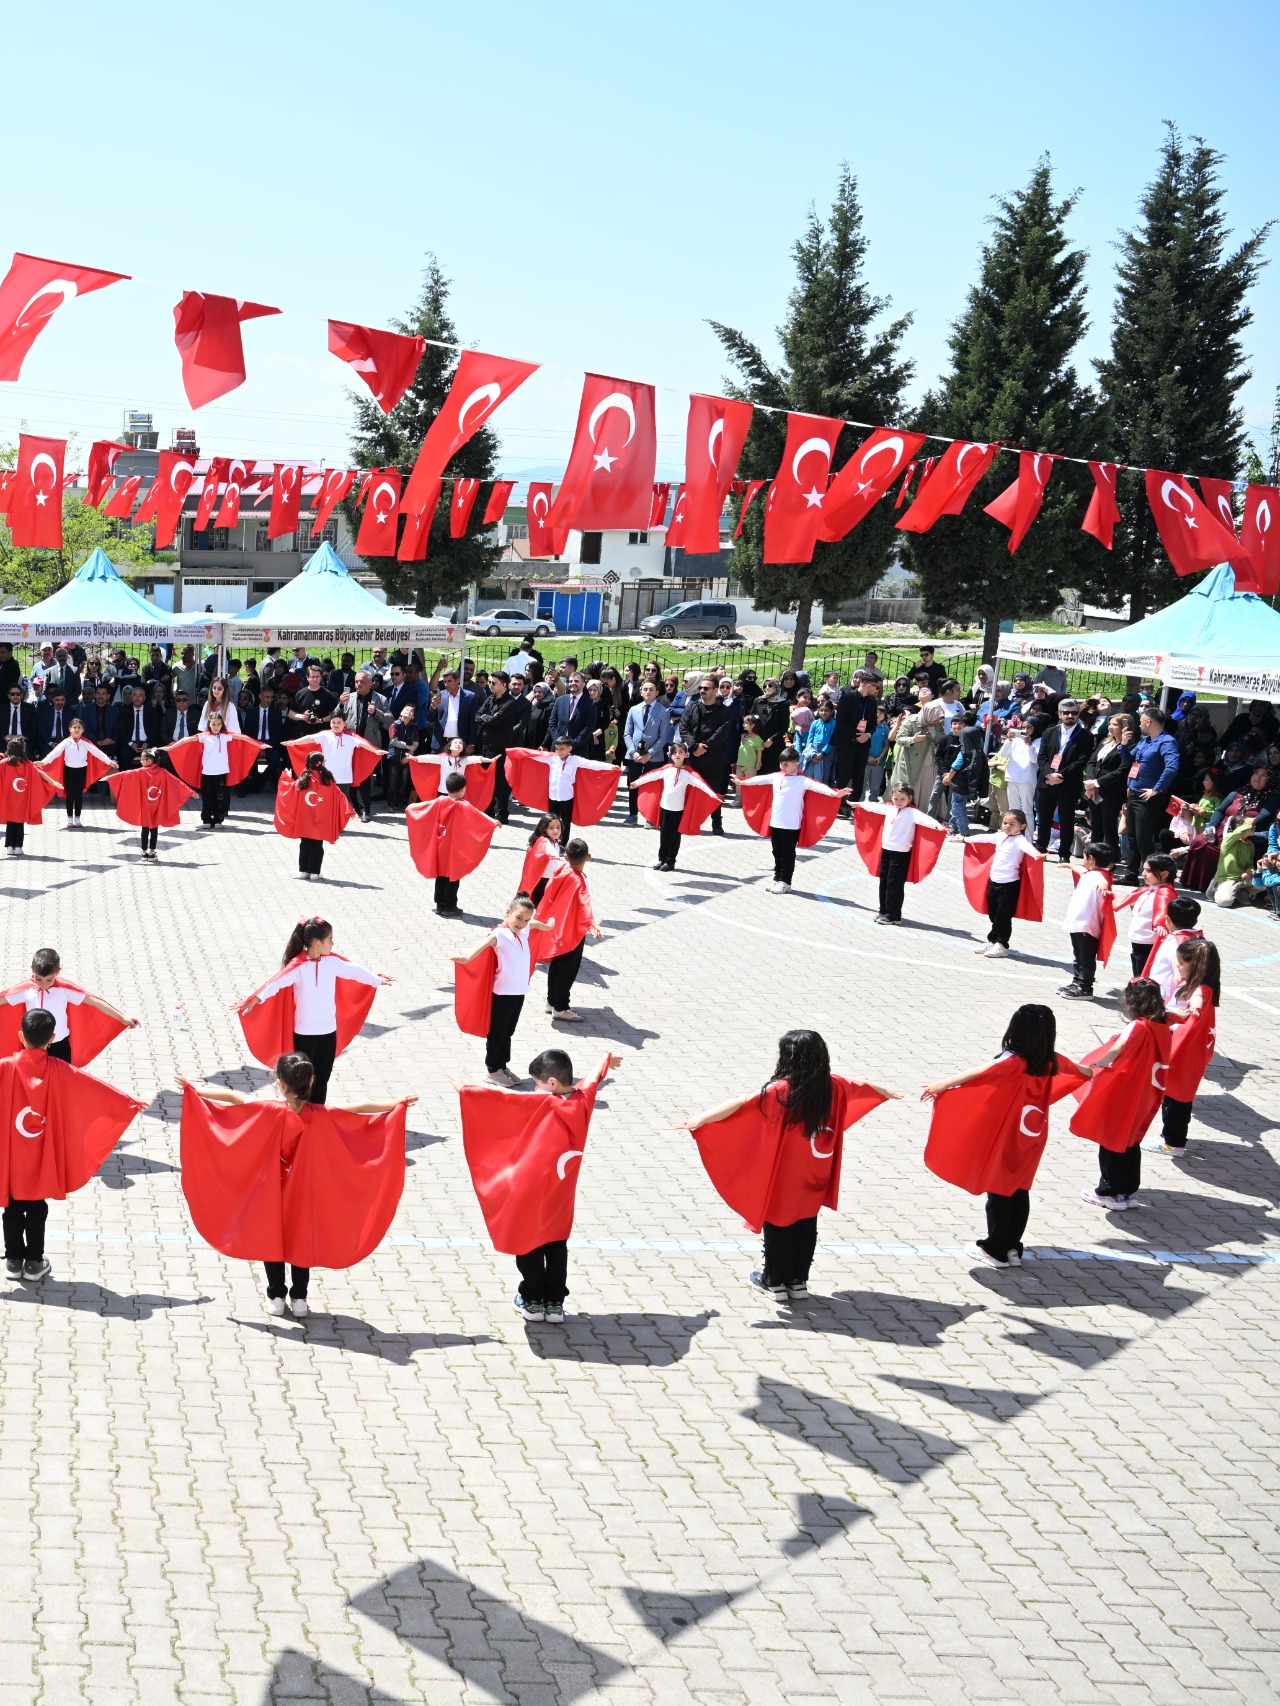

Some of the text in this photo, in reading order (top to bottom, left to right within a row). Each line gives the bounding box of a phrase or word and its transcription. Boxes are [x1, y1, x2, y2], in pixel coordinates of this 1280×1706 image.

[35, 623, 169, 639] Kahramanmaraş Büyükşehir Belediyesi
[277, 628, 410, 643] Kahramanmaraş Büyükşehir Belediyesi
[1029, 645, 1069, 663] Kahramanmaraş
[1070, 648, 1098, 666] Büyükşehir
[1099, 651, 1126, 670] Belediyesi
[1209, 668, 1260, 692] Kahramanmaraş
[1260, 673, 1280, 695] Büyü
